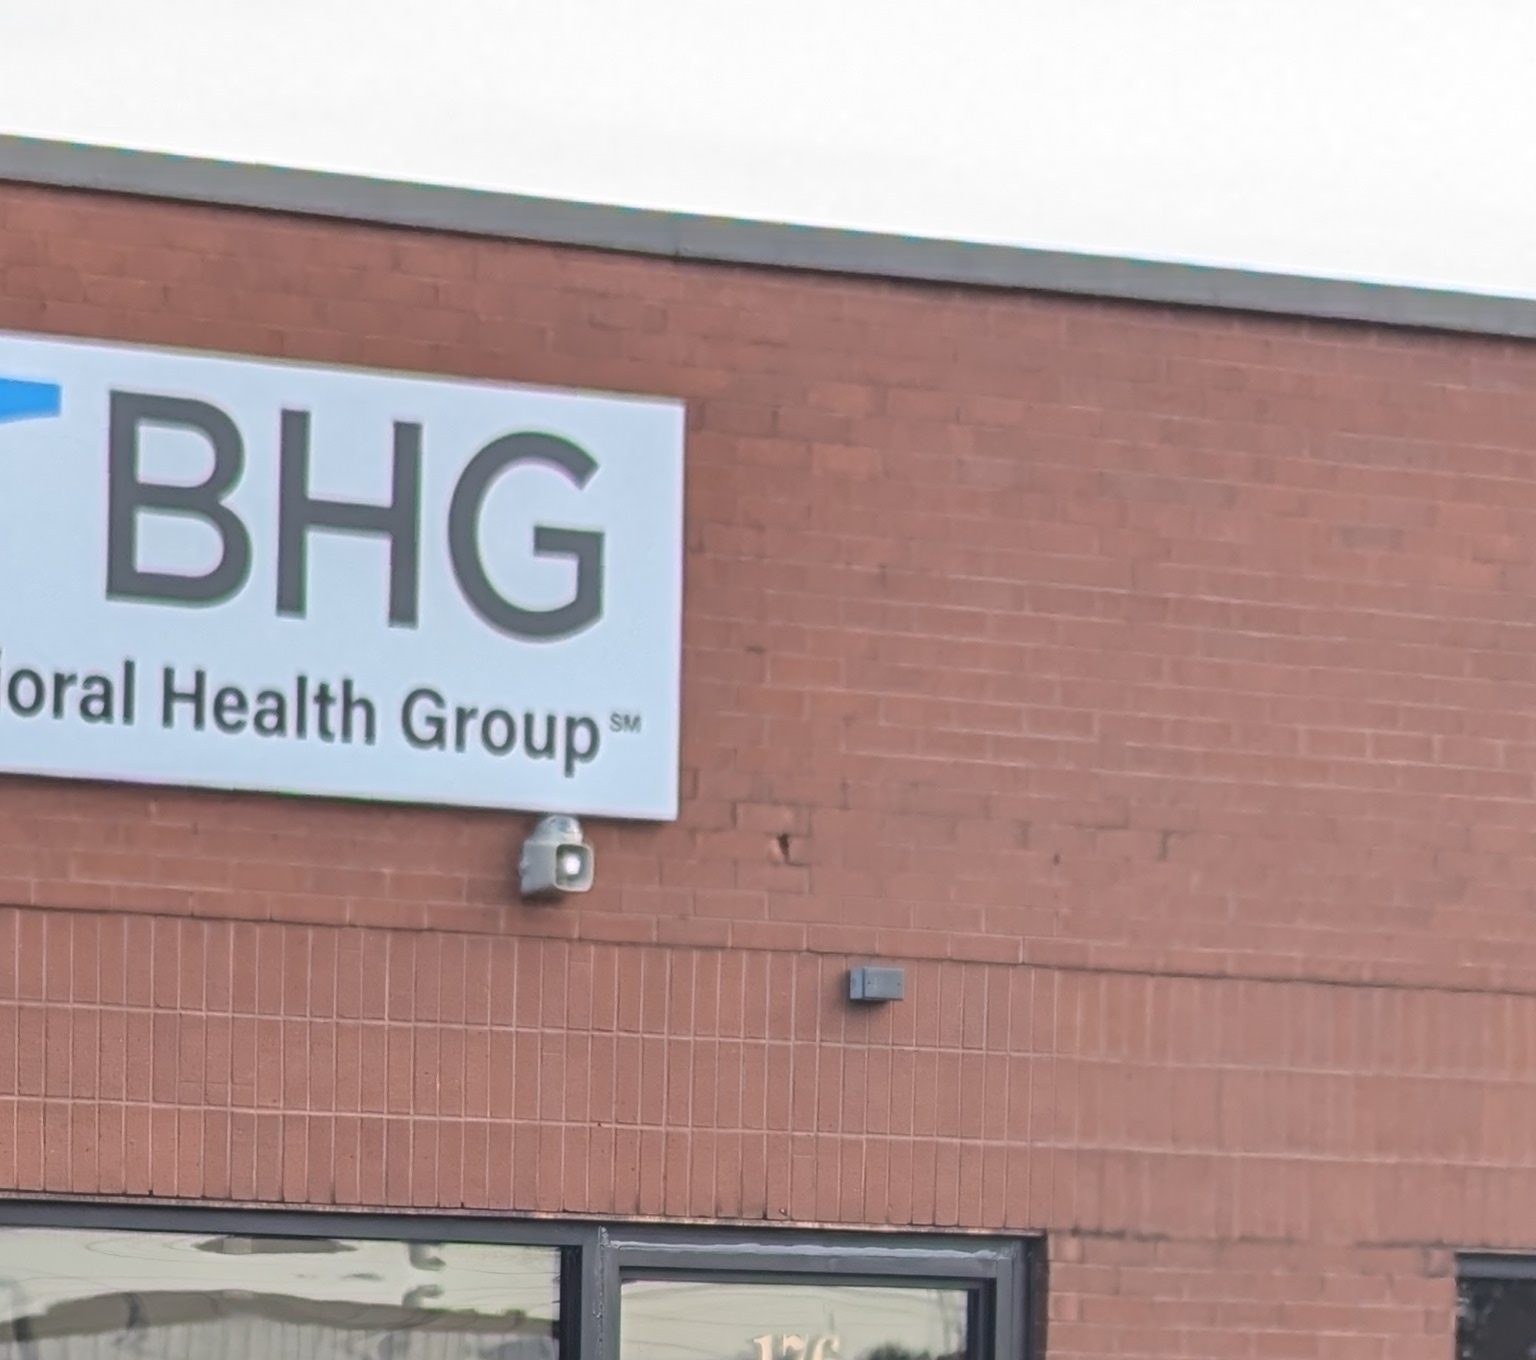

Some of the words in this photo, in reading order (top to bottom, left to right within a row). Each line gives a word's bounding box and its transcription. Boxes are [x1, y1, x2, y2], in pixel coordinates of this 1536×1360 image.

[105, 389, 606, 643] BHG
[162, 665, 378, 746] Health
[400, 688, 601, 773] Group
